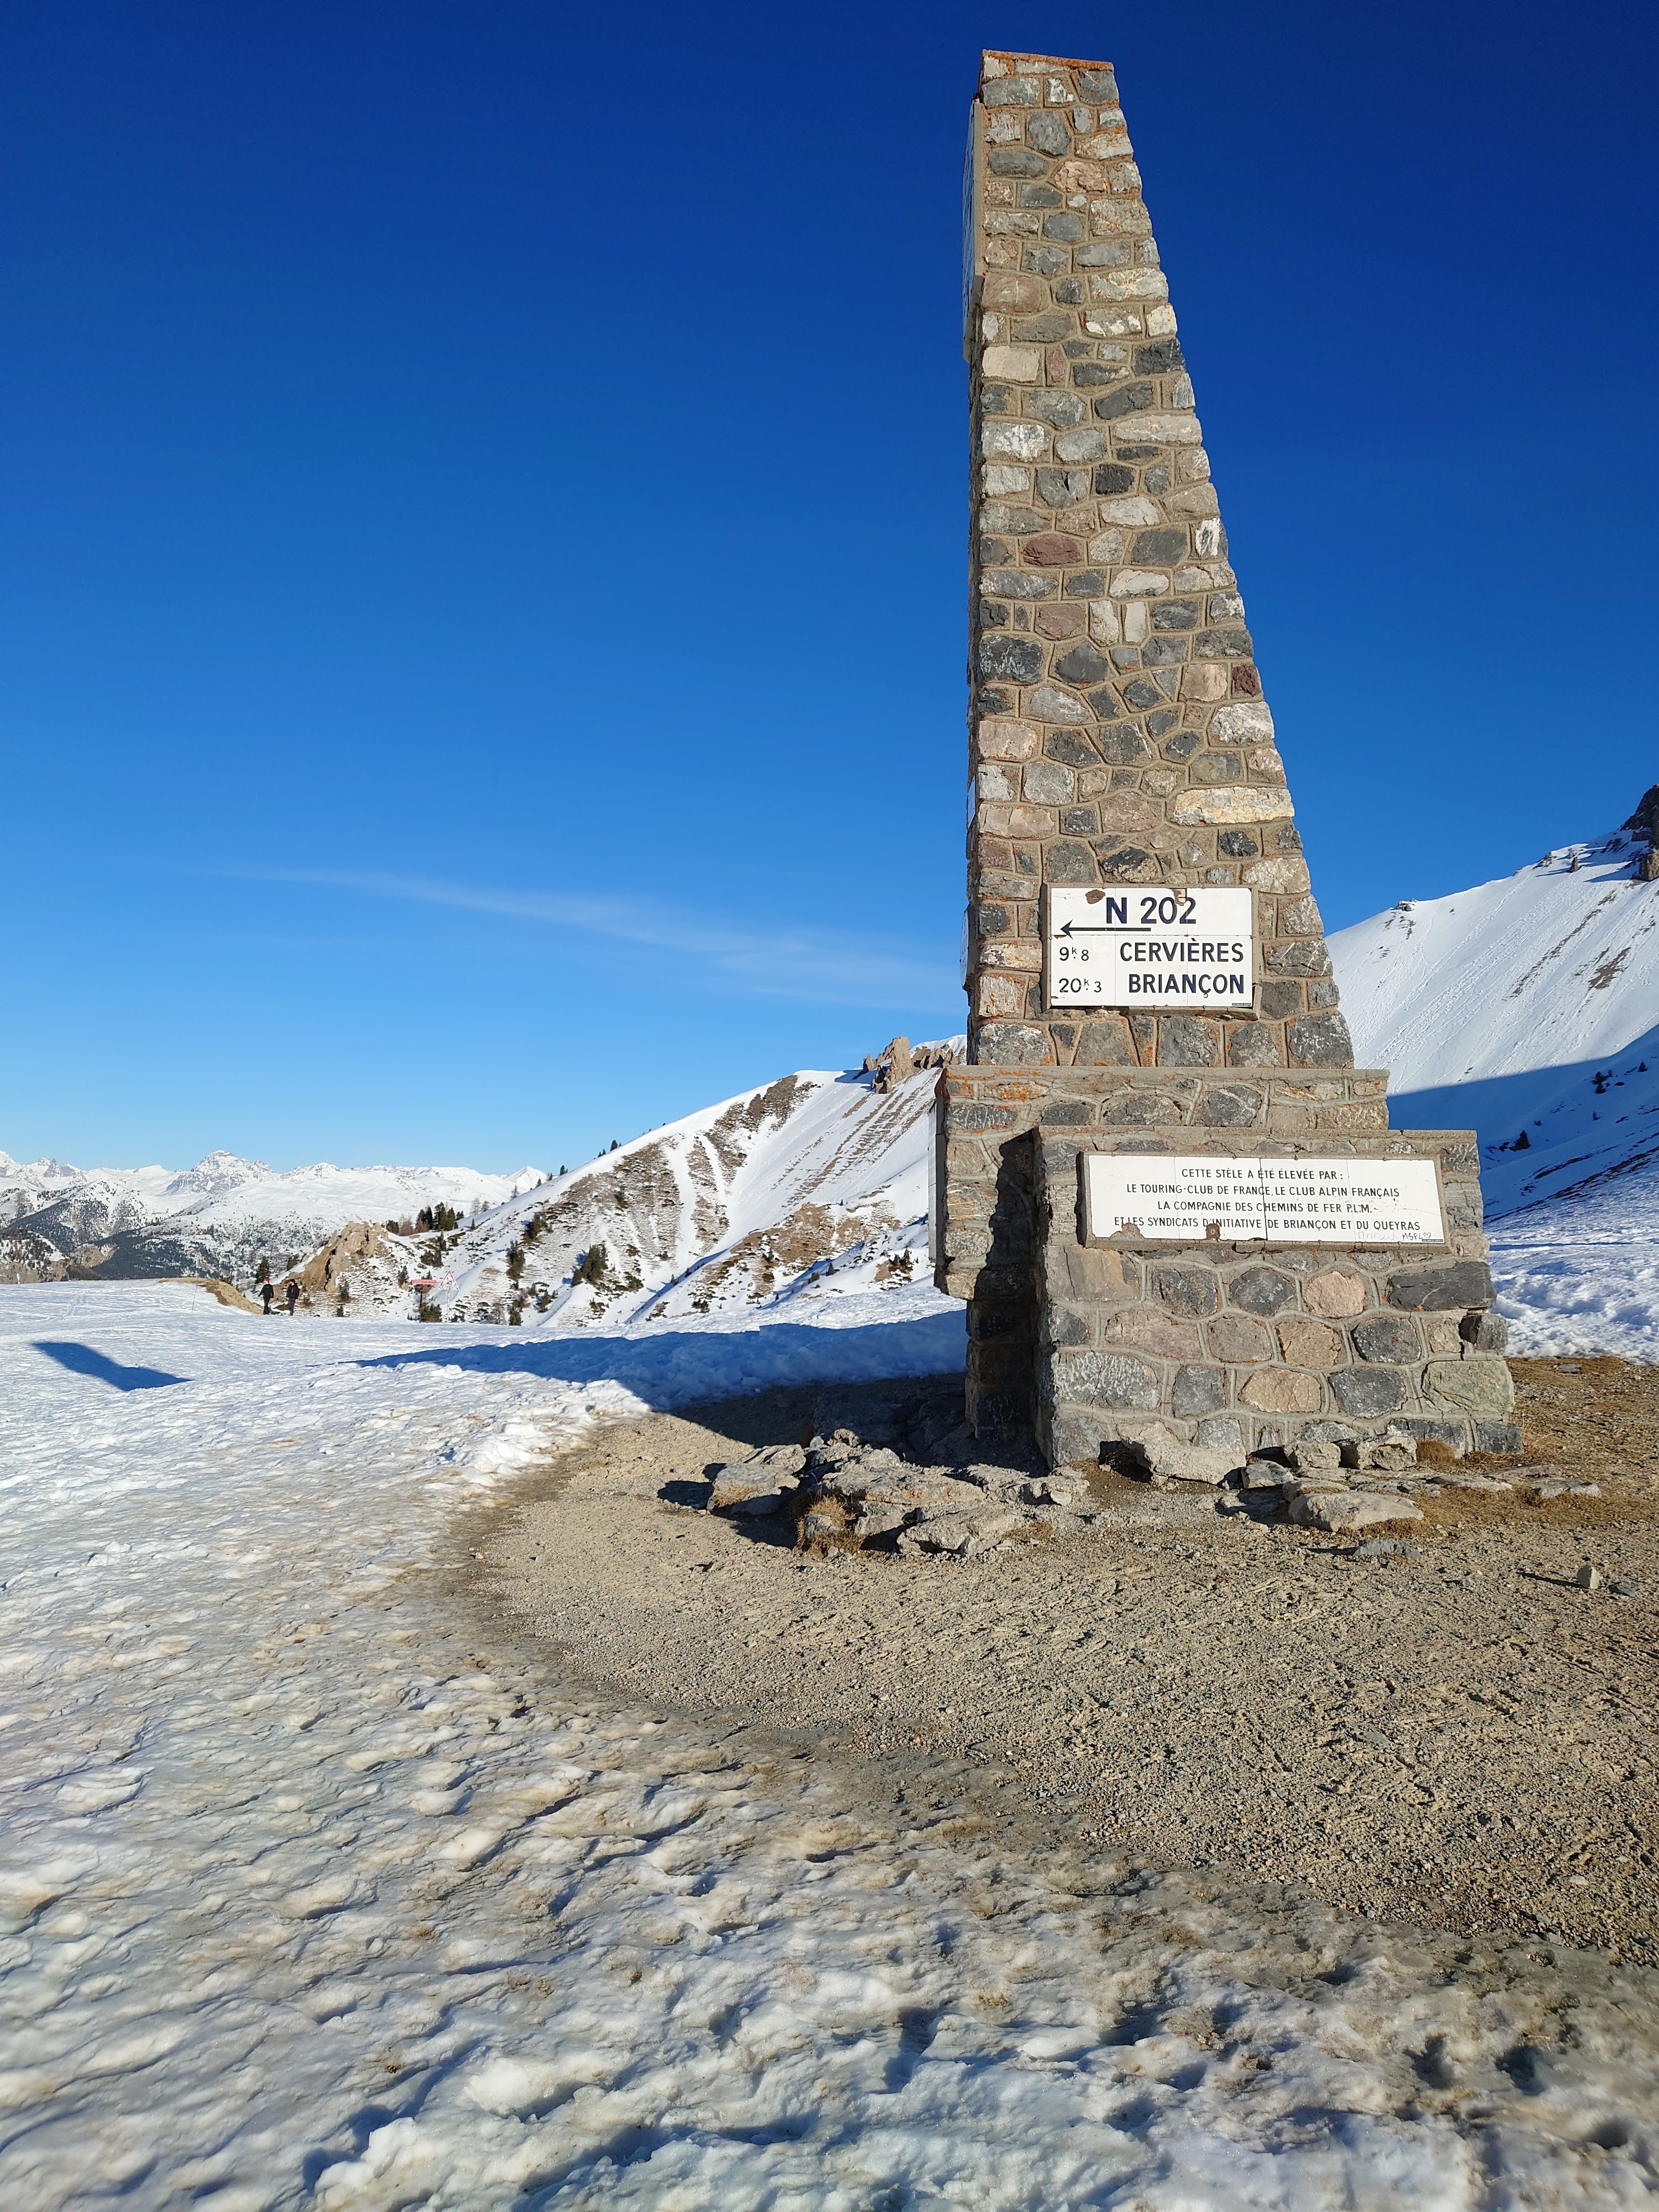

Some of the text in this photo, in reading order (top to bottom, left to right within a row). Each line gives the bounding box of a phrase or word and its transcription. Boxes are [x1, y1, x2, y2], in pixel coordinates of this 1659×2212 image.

[1106, 896, 1197, 924] N 202
[1120, 938, 1244, 962] CERVIÈRES
[1128, 974, 1244, 998] BRIANÇON
[1182, 1169, 1211, 1178] CETTE
[1216, 1167, 1243, 1178] STÈLE
[1248, 1170, 1254, 1178] A
[1257, 1168, 1275, 1178] ÉTÉ
[1278, 1169, 1314, 1180] ÉLEVÉE
[1127, 1184, 1400, 1199] LE TOURING-CLUB DE FRANCE, LE CLUB ALPIN FRANÇAIS
[1158, 1201, 1372, 1213] LA COMPAGNIE DES CHEMINS DE FER P.L.M.
[1115, 1217, 1124, 1226] ET
[1148, 1217, 1199, 1227] SYNDICATS
[1268, 1220, 1279, 1228] DE
[1284, 1220, 1336, 1231] BRIANÇON
[1341, 1221, 1351, 1229] ET
[1357, 1221, 1369, 1229] DU
[1374, 1221, 1420, 1231] QUEYRAS
